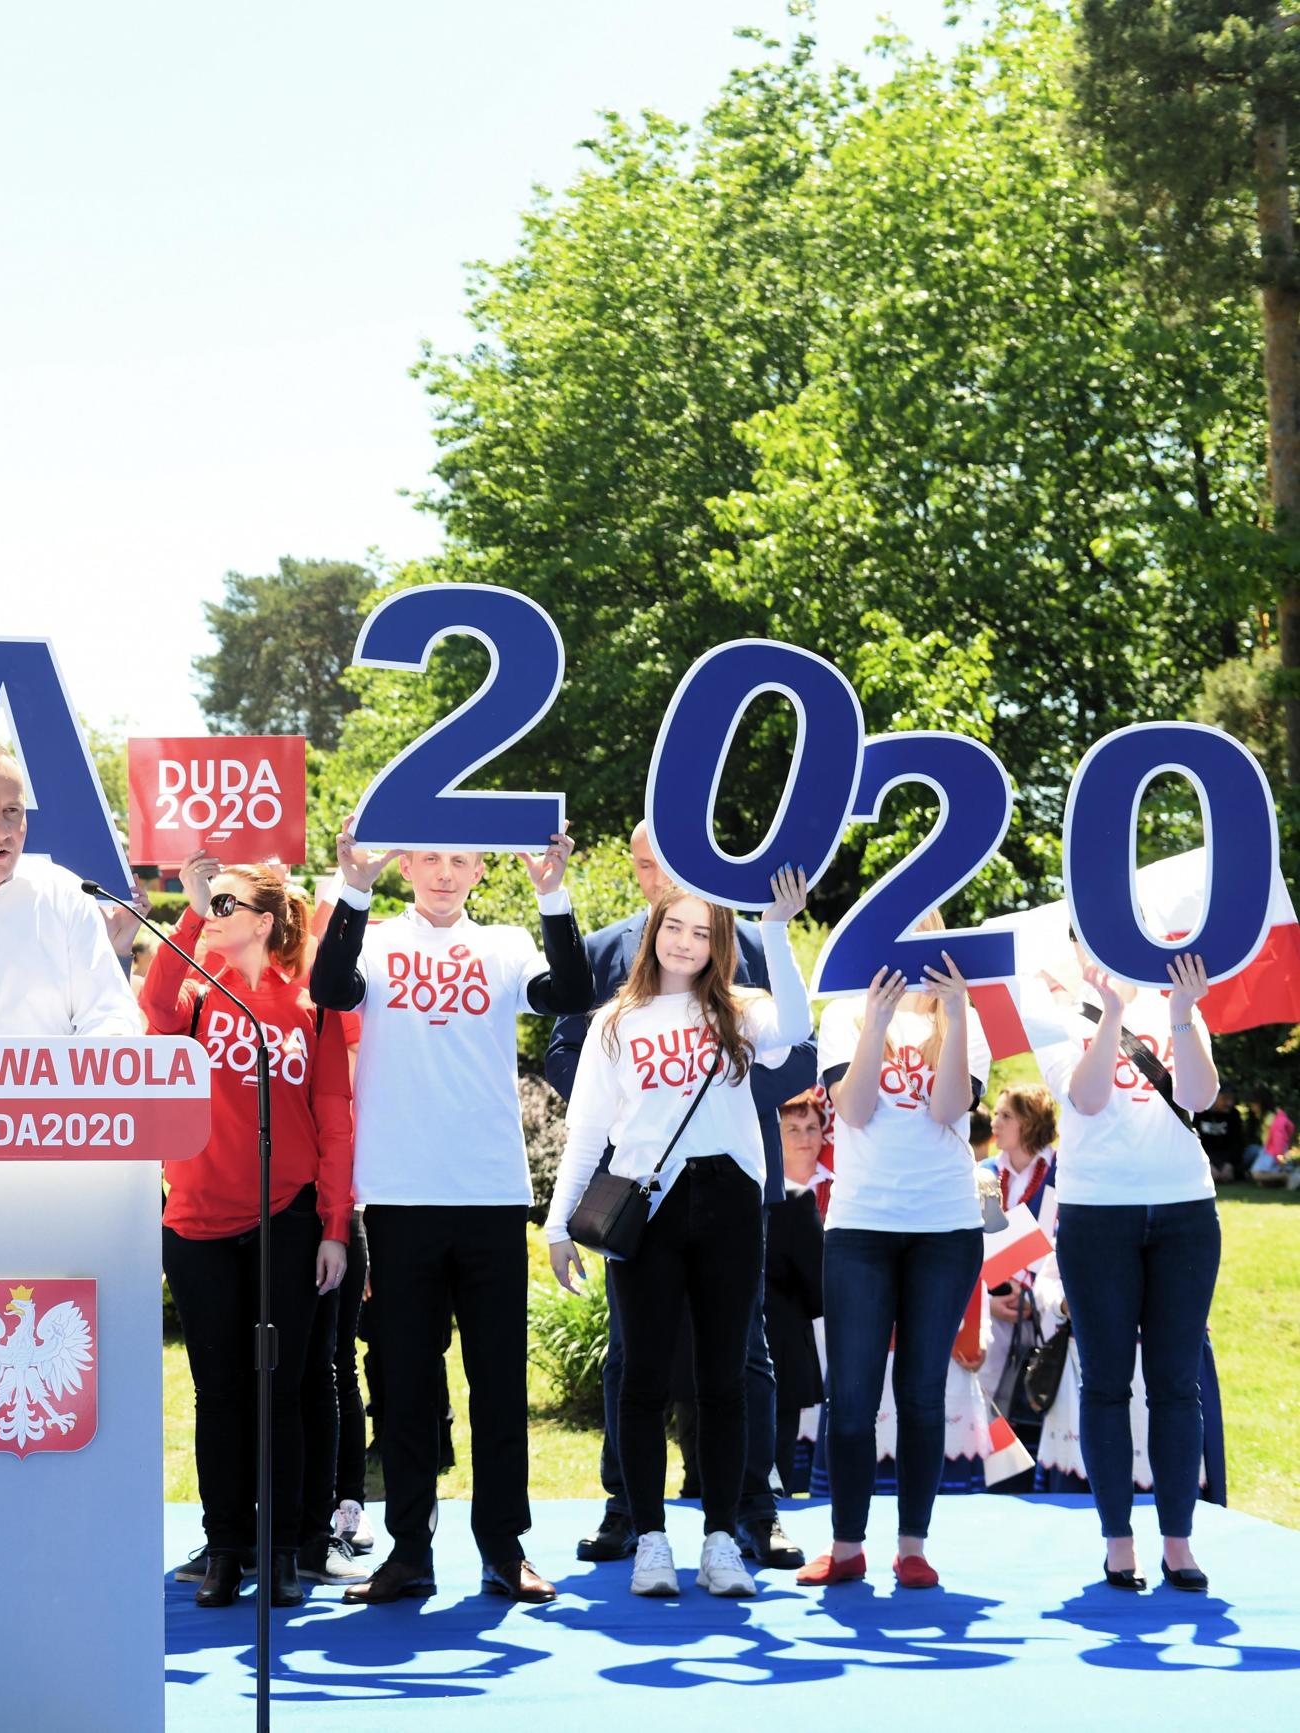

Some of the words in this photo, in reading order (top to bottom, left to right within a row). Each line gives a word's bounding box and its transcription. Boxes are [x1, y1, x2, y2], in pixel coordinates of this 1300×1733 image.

[158, 759, 282, 794] DUDA
[155, 793, 283, 830] 2020
[387, 951, 488, 986] DUDA
[387, 980, 490, 1015] 2020
[207, 1010, 308, 1059] DUDA
[68, 1048, 196, 1086] WOLA
